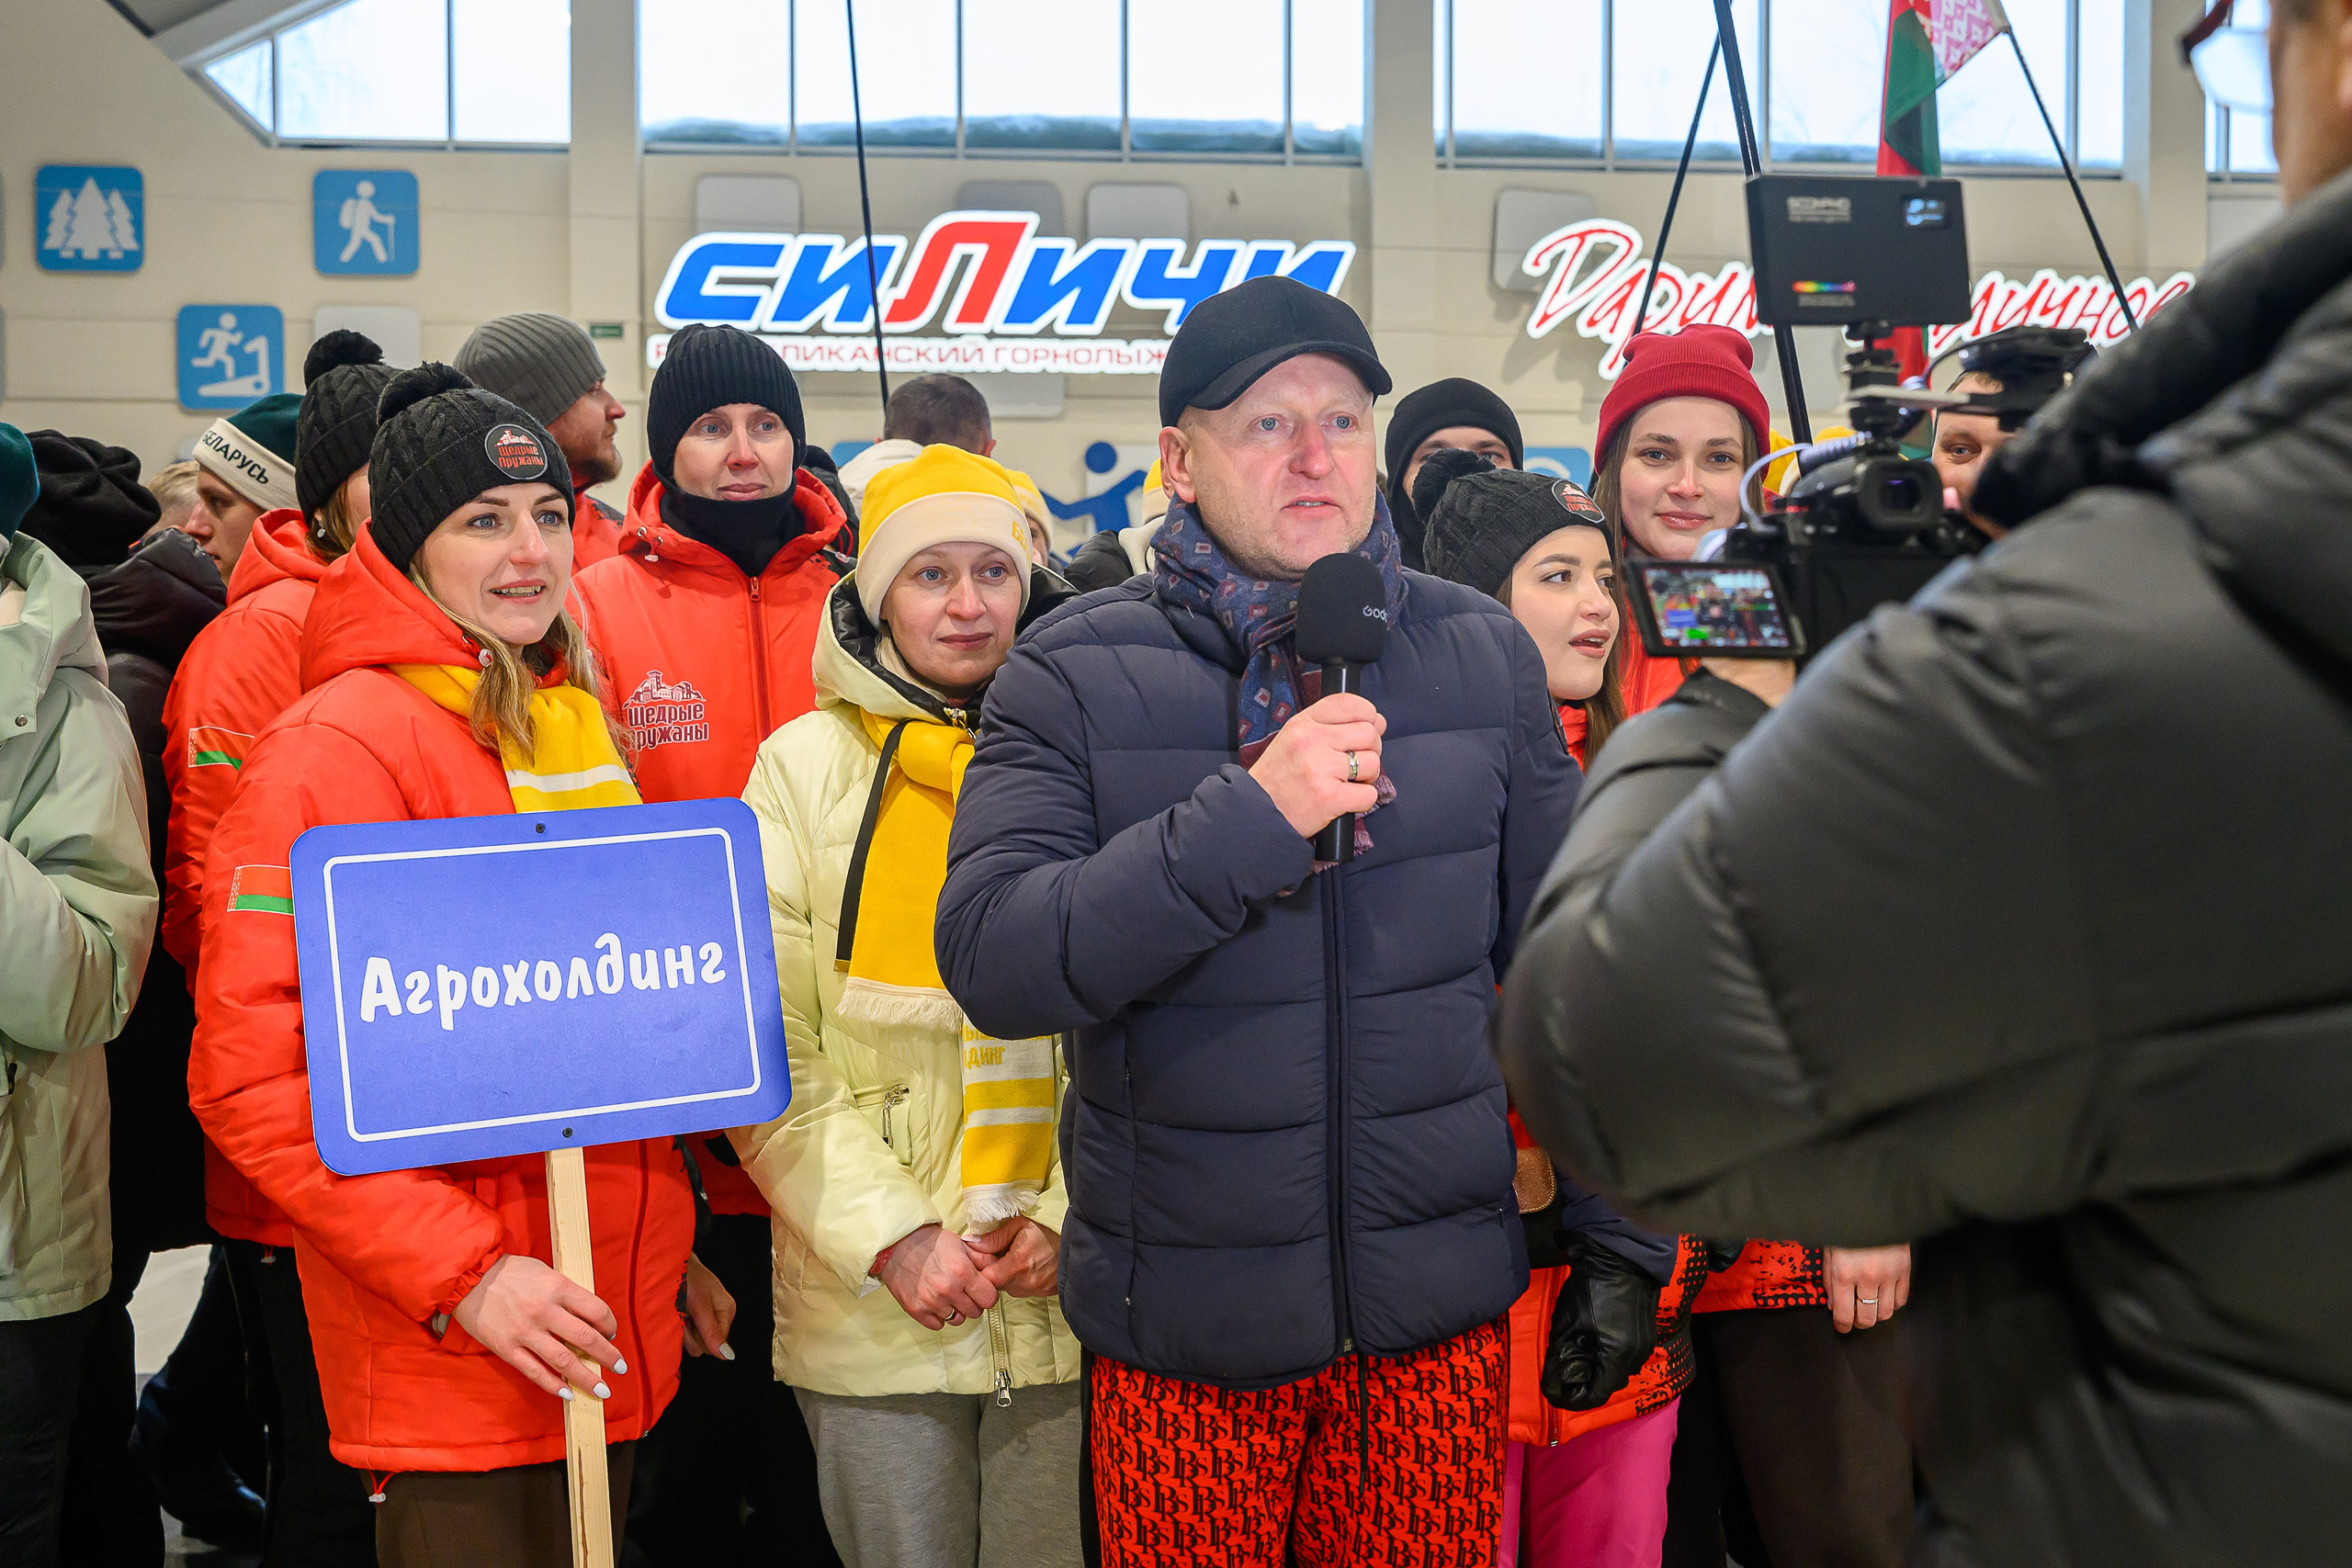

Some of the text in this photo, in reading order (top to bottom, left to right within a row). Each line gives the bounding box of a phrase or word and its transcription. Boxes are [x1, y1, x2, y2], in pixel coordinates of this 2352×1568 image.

[1929, 271, 2192, 354] личное
[655, 342, 1166, 365] РЛИКАНСКИЙ ГОРНОЛЫЖ
[202, 430, 269, 484] БЕЛАРУСЬ
[497, 446, 539, 457] Щедрые
[497, 456, 544, 468] Пружаны
[628, 703, 705, 728] Щедрые
[359, 931, 728, 1032] Агрохолдинг
